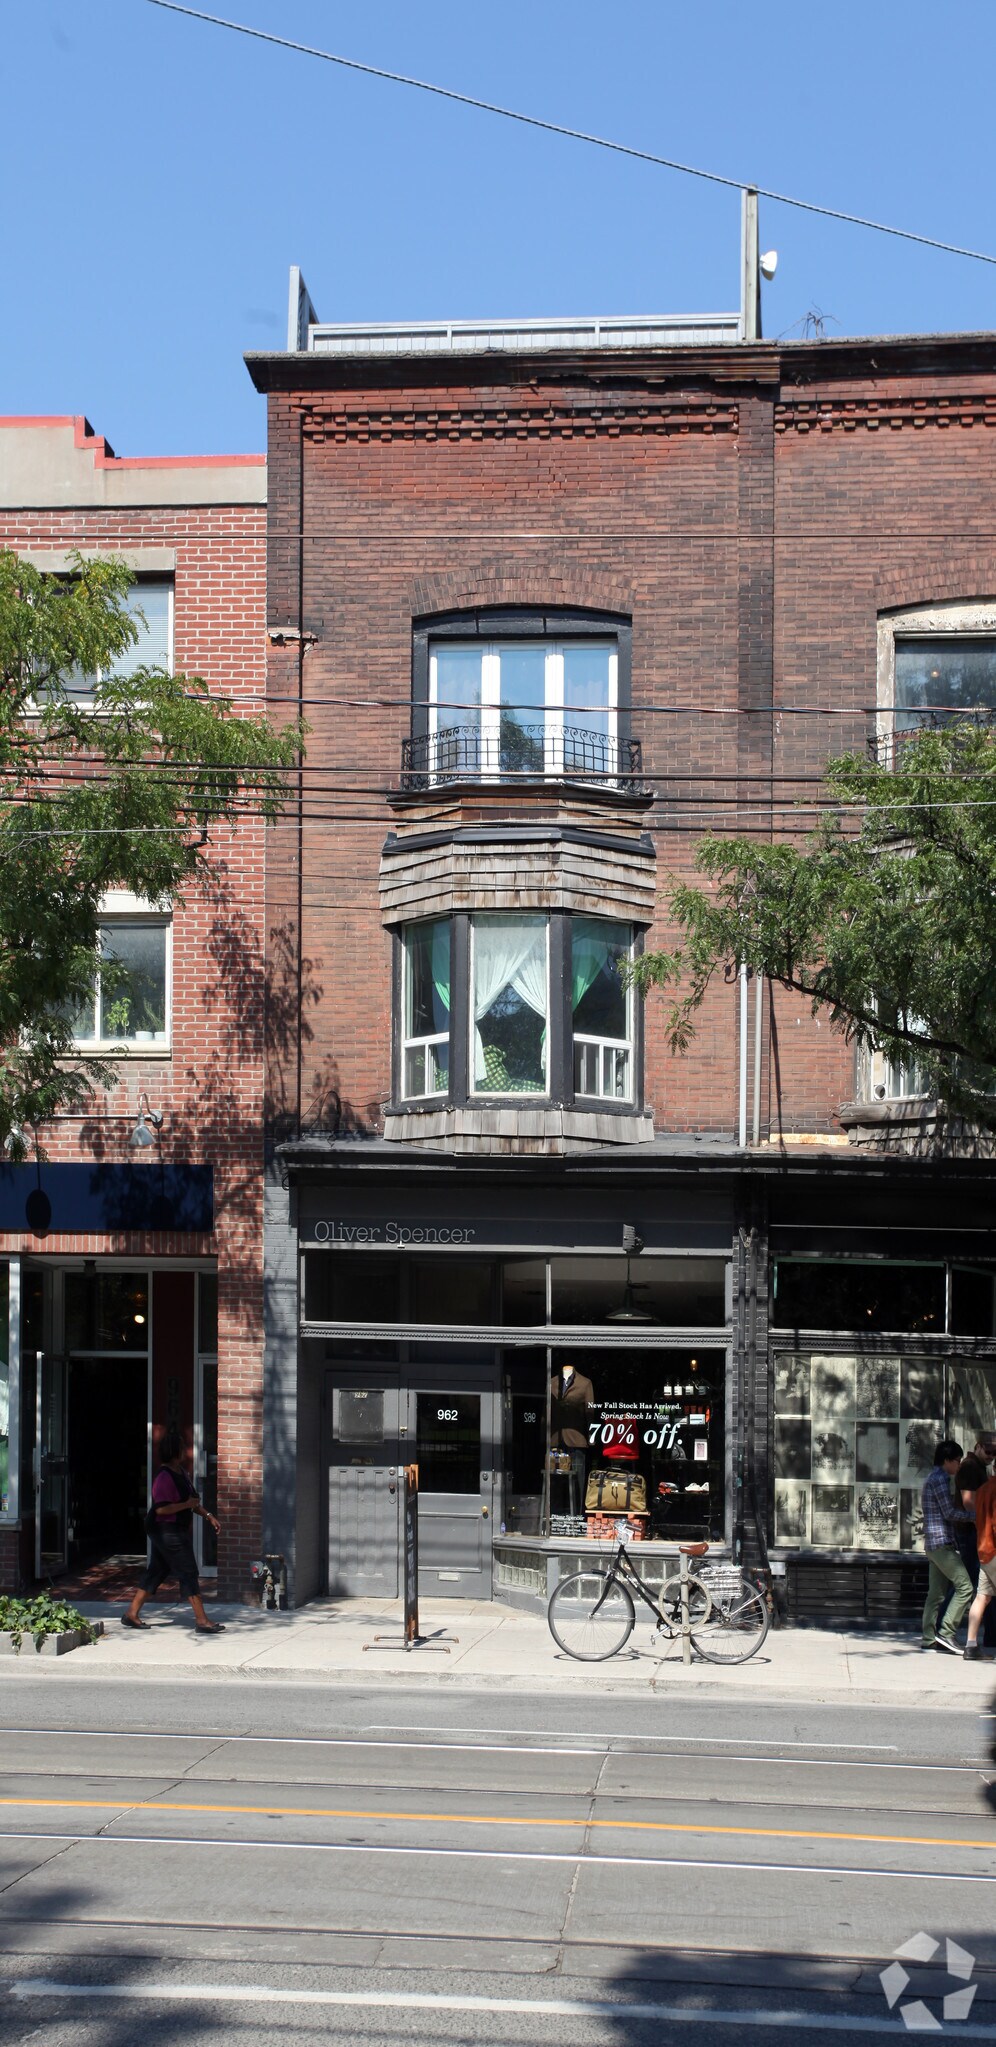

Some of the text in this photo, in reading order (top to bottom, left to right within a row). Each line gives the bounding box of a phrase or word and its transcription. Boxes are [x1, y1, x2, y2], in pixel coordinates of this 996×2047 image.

[314, 1220, 476, 1249] Oliver Spencer
[653, 1402, 682, 1410] Arrived.
[437, 1409, 458, 1421] 962
[600, 1411, 670, 1420] Spring Stock Is Now
[588, 1422, 683, 1450] 70% off.
